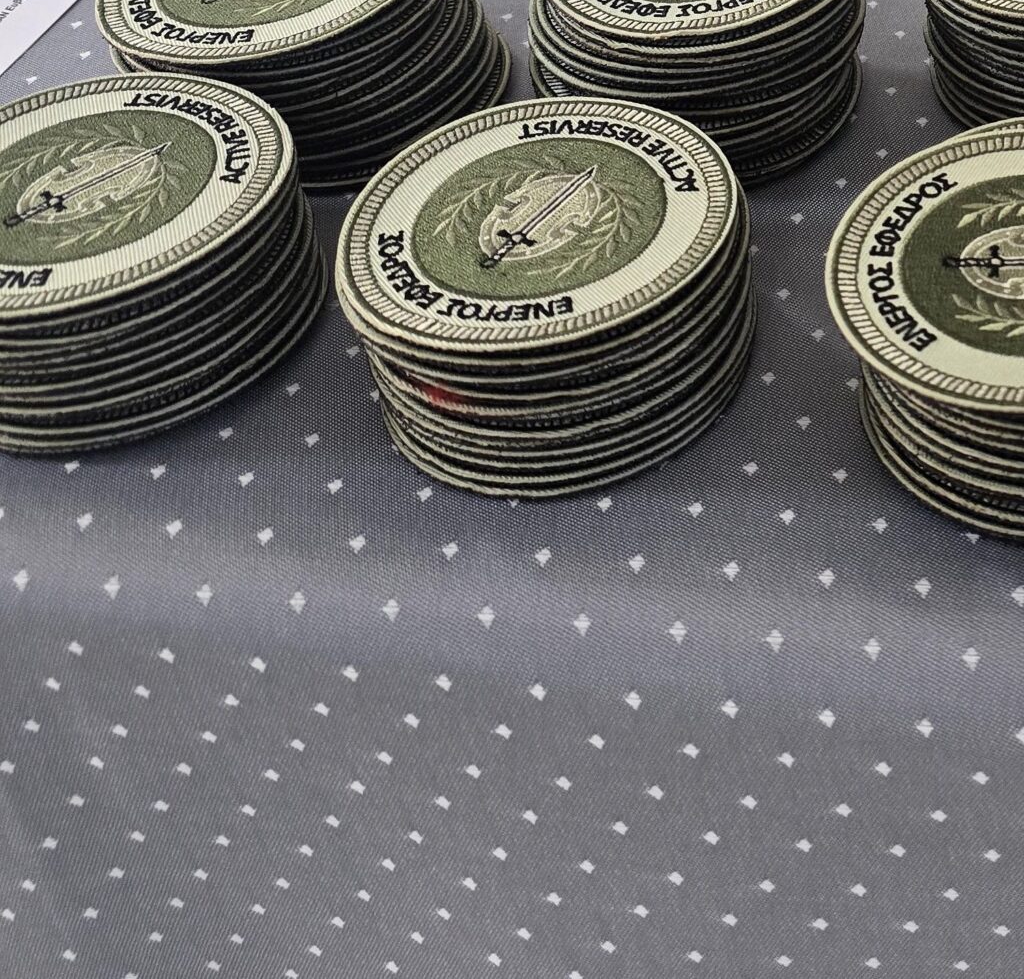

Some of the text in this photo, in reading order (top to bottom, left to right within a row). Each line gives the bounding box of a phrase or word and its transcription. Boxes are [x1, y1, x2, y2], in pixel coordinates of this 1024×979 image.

[151, 23, 255, 44] ΕΝΕΡΓΟΣ
[124, 93, 251, 184] ACTIVE RESERVIST
[518, 120, 699, 192] ACTIVE RESERVIST
[378, 230, 573, 321] ΕΝΕΡΓΟΣ ΕΦΕΔΡΟΣ
[867, 173, 958, 351] ΕΝΕΡΓΟΣ ΕΦΕΔΡΟΣ
